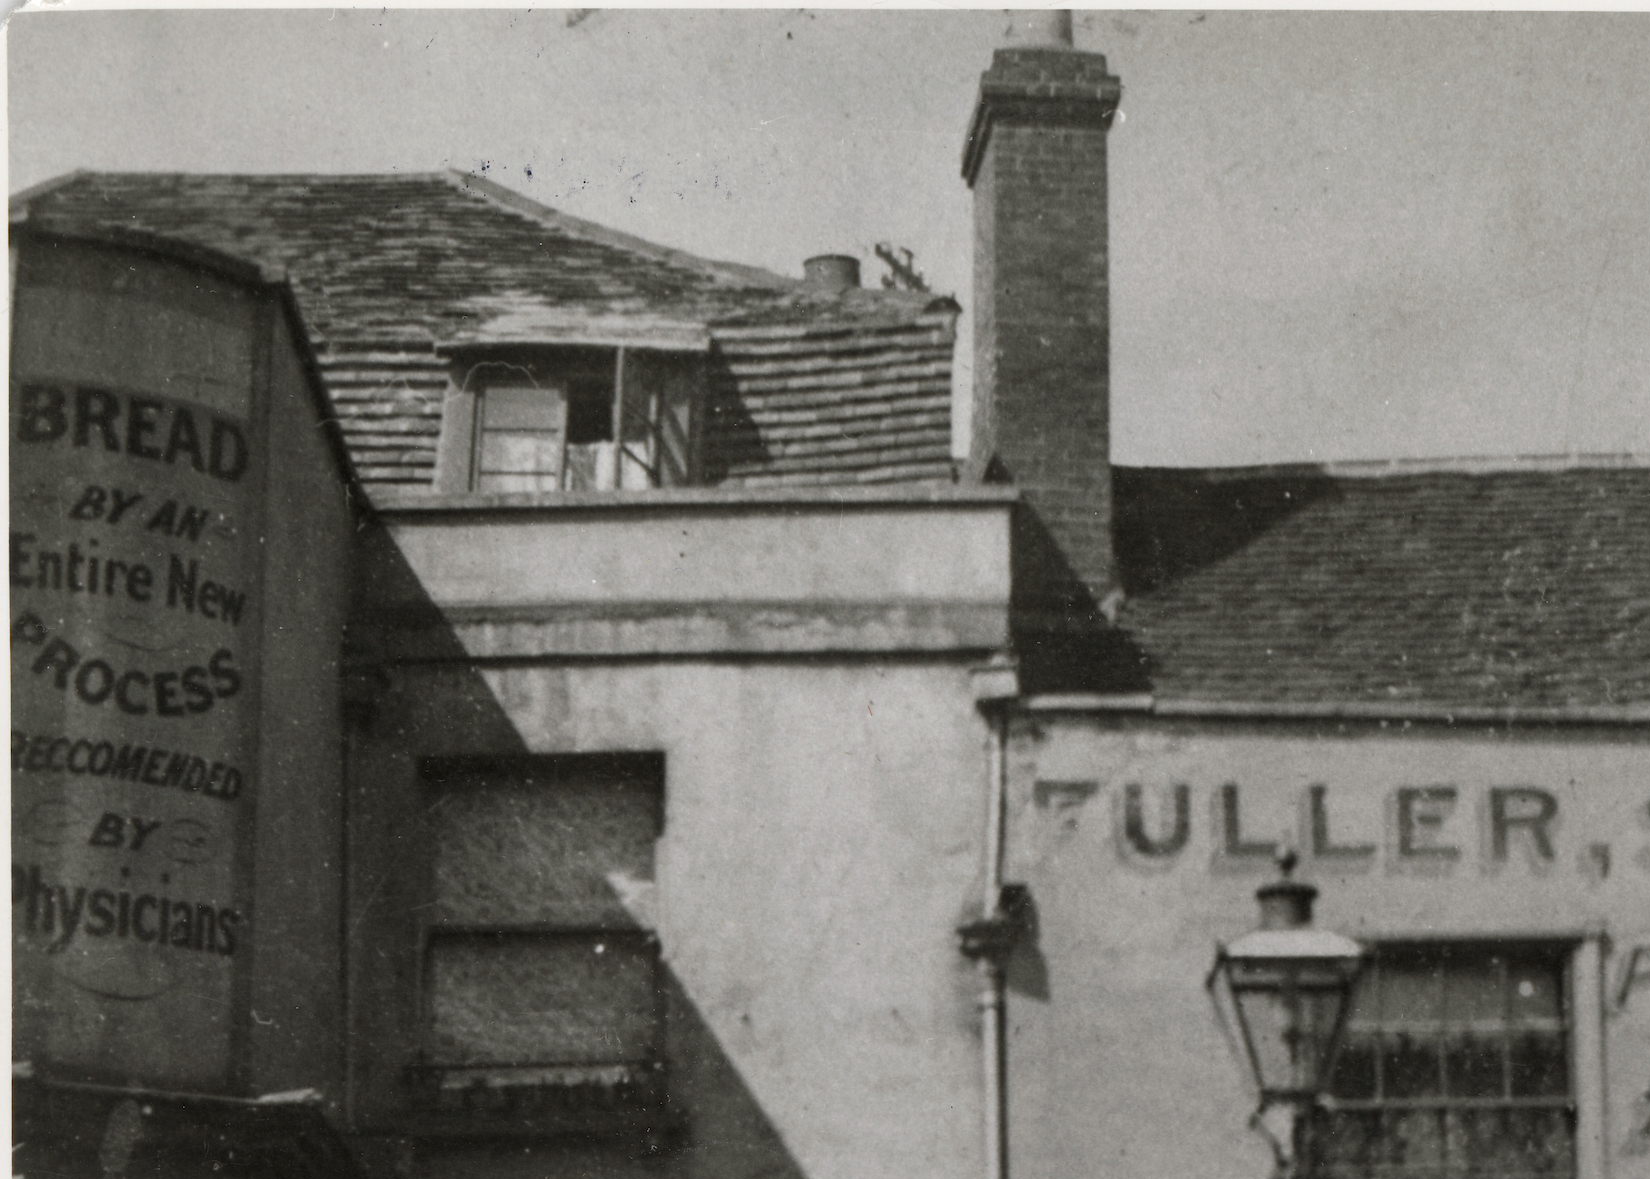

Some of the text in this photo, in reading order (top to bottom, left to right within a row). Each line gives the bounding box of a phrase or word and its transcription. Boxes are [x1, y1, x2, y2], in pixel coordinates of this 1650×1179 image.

[17, 380, 249, 484] BREAD
[69, 483, 210, 543] BY AN
[12, 531, 246, 628] Entire New
[12, 610, 243, 718] PROCESS
[87, 811, 163, 852] BY
